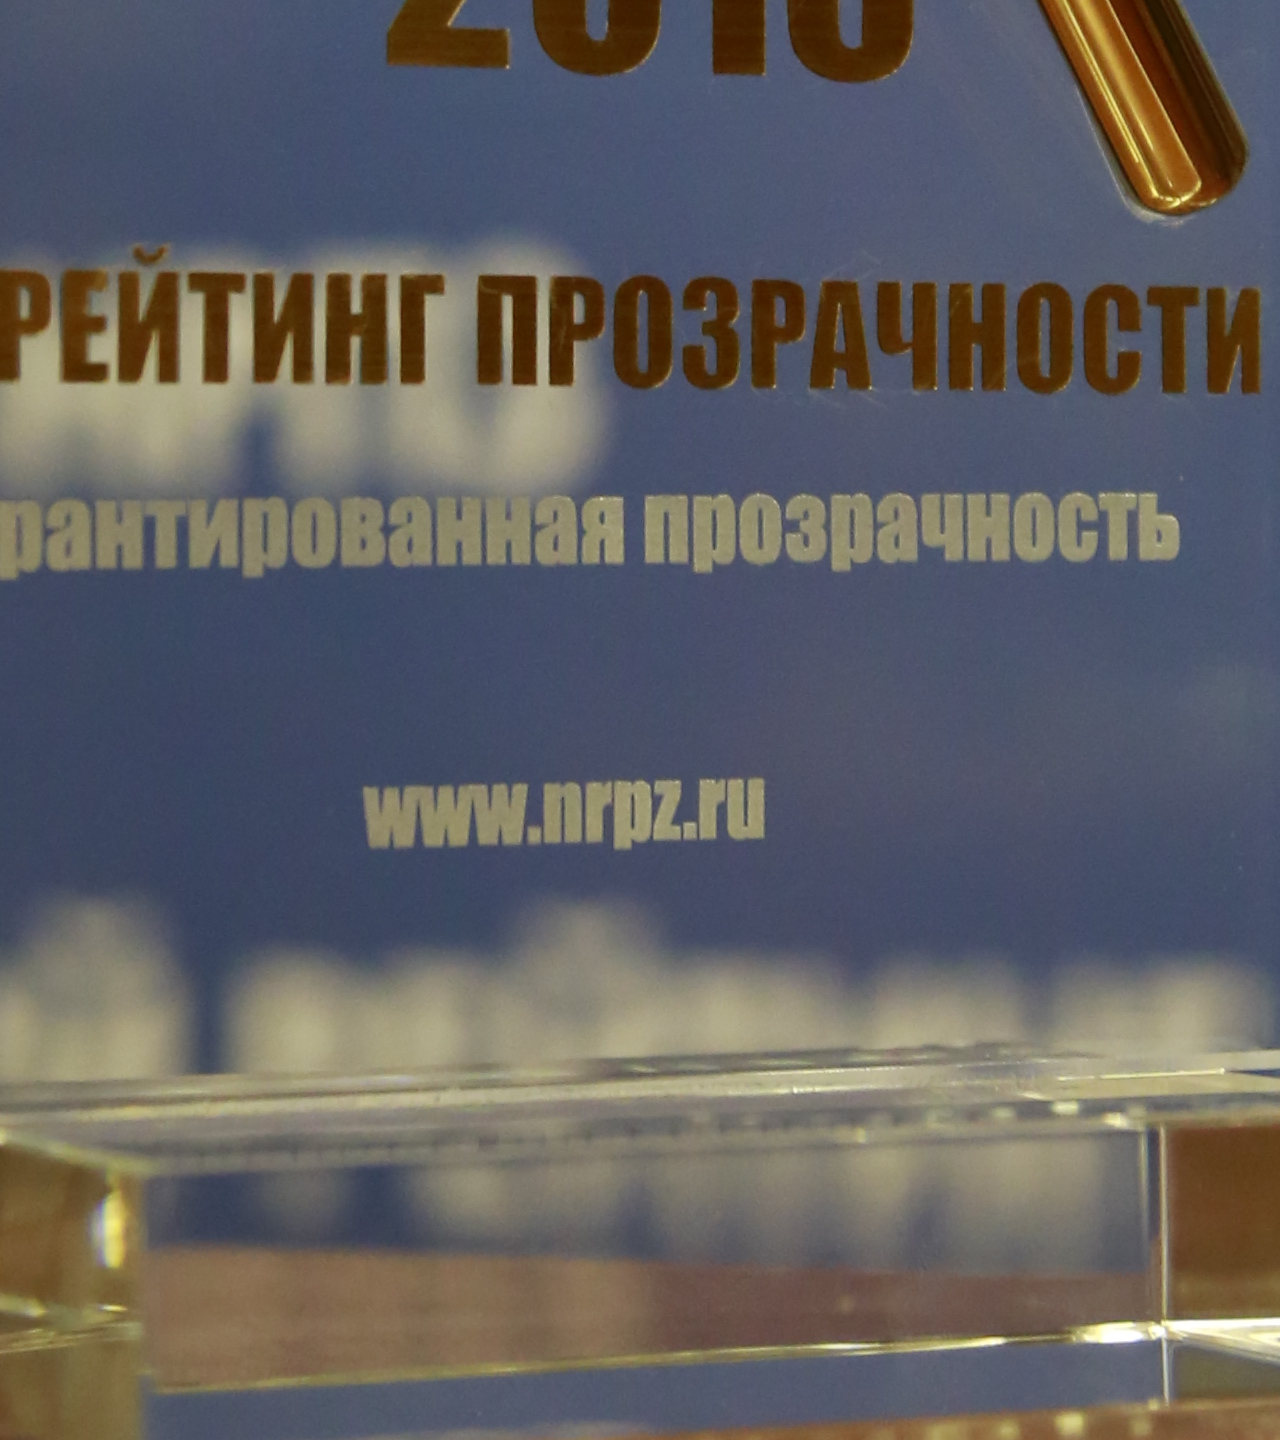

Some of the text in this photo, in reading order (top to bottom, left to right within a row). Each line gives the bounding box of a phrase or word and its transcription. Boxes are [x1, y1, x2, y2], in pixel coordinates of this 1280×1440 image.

[476, 274, 1263, 396] ПРОЗРАЧНОСТИ
[643, 491, 1182, 575] прозрачность
[363, 776, 766, 850] www.nrpz.ru
